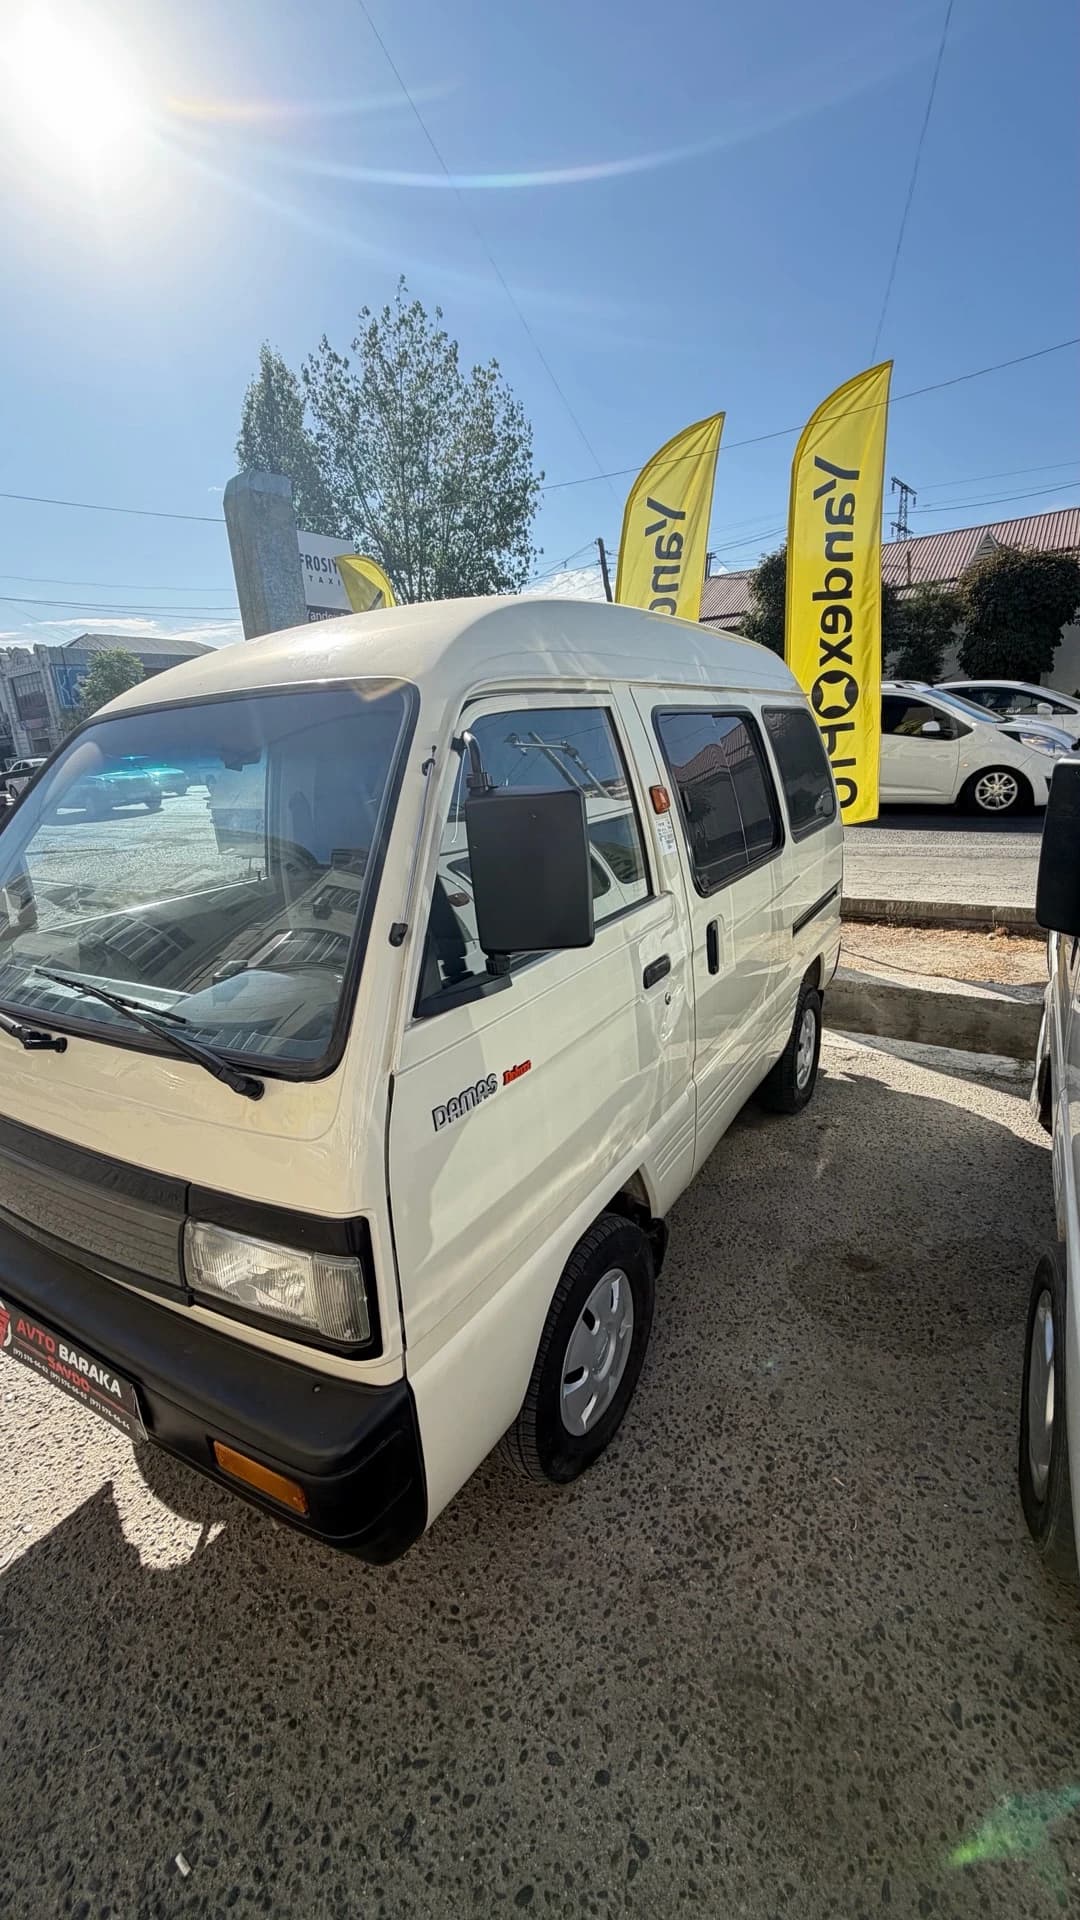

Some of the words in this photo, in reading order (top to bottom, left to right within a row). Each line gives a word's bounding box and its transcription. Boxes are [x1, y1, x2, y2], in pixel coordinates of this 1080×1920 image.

[431, 1072, 498, 1132] DAMAS
[16, 1319, 56, 1353] AVTO
[58, 1343, 122, 1398] BARAKA
[47, 1355, 91, 1392] SAVDO
